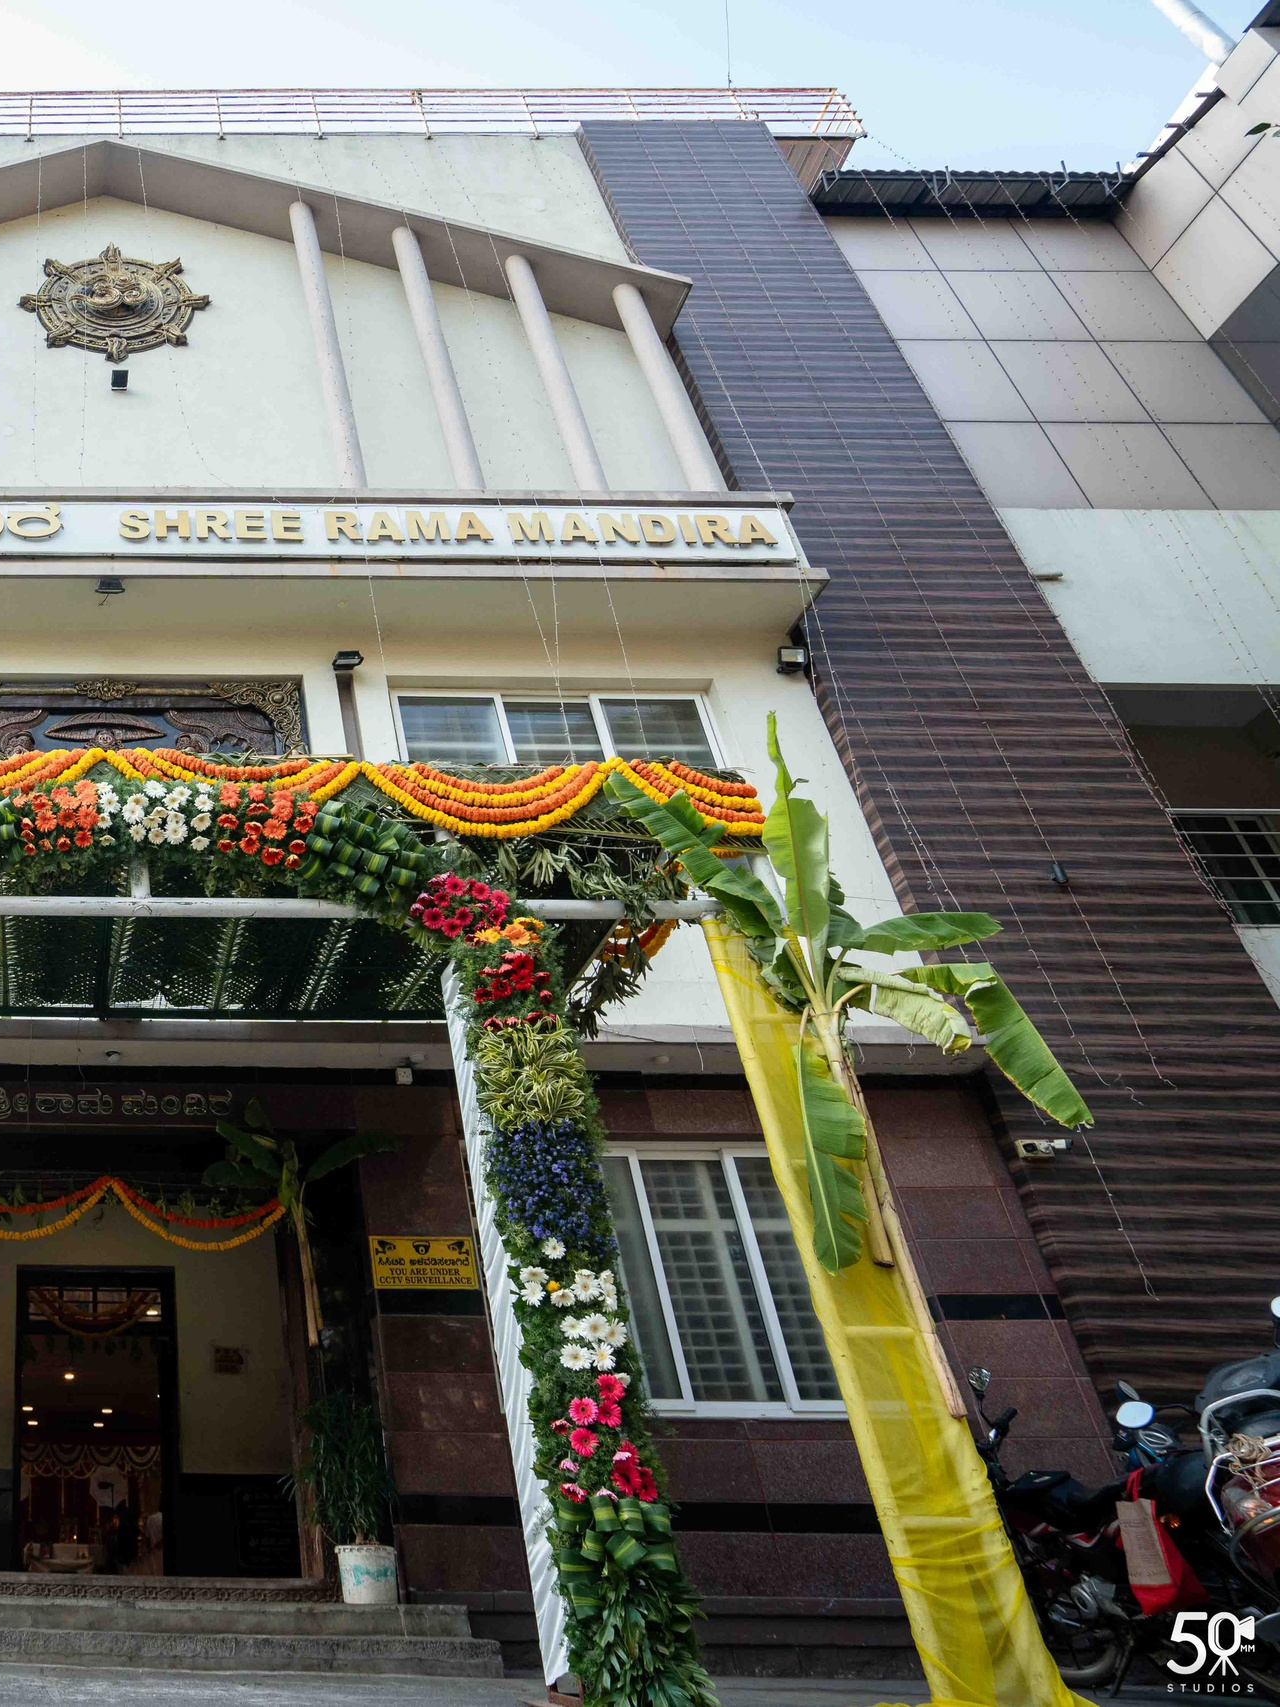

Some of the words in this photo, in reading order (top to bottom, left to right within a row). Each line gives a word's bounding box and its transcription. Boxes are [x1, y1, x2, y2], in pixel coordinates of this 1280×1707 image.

[118, 509, 304, 543] SHREE
[324, 510, 494, 543] RAMA
[508, 512, 779, 547] MANDIRA
[35, 1088, 114, 1115] ರಾಮ
[121, 1088, 233, 1116] ಮಂದಿರ
[379, 1276, 403, 1284] CCTV
[405, 1276, 472, 1284] SURVEILLANCE
[389, 1268, 407, 1276] YOU
[410, 1268, 428, 1276] ARE
[430, 1268, 460, 1276] UNDER
